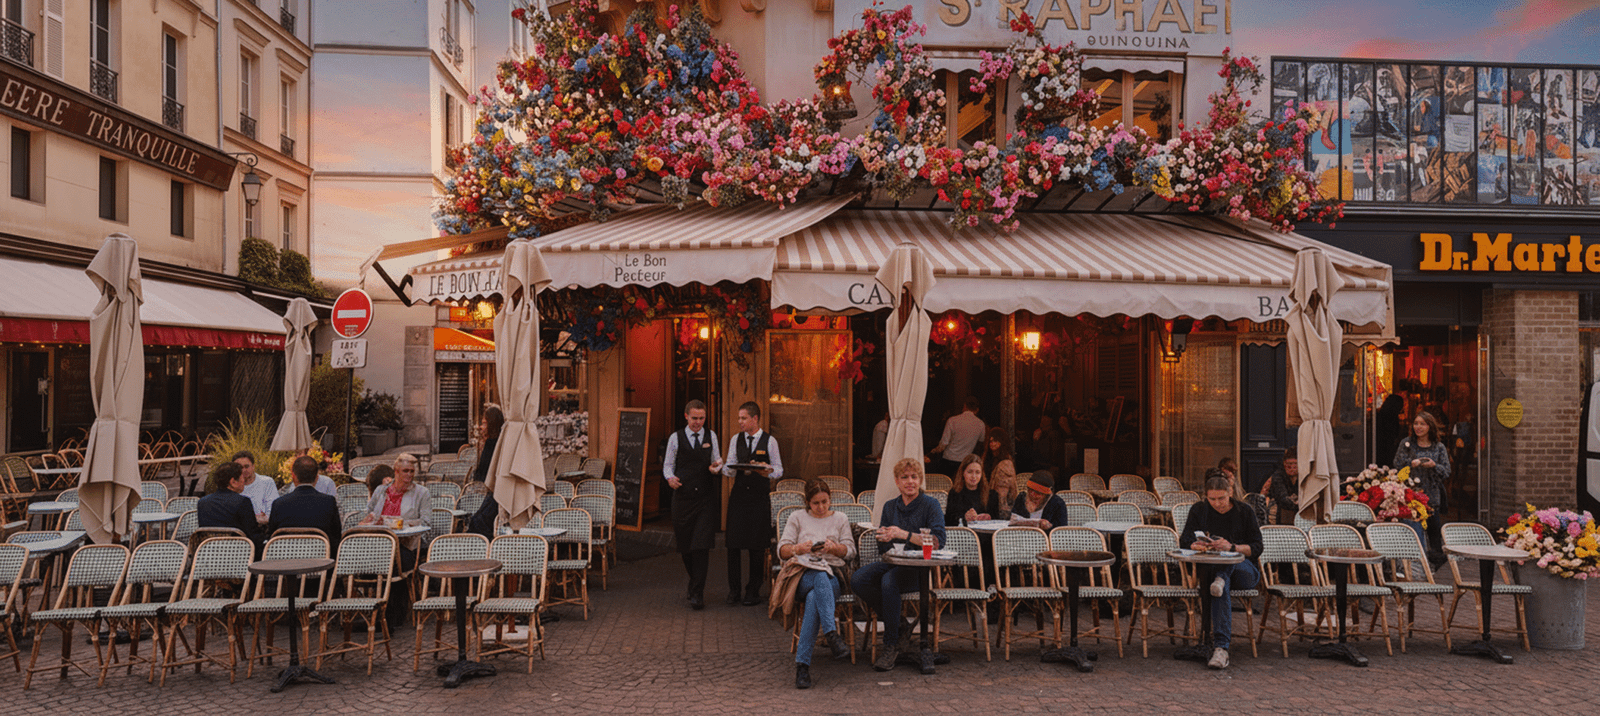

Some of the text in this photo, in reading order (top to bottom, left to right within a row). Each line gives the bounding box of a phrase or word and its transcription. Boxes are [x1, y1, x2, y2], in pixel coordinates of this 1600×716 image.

[86, 110, 200, 174] TRANQUILLE
[625, 253, 667, 267] Le Bon
[848, 283, 892, 305] CA
